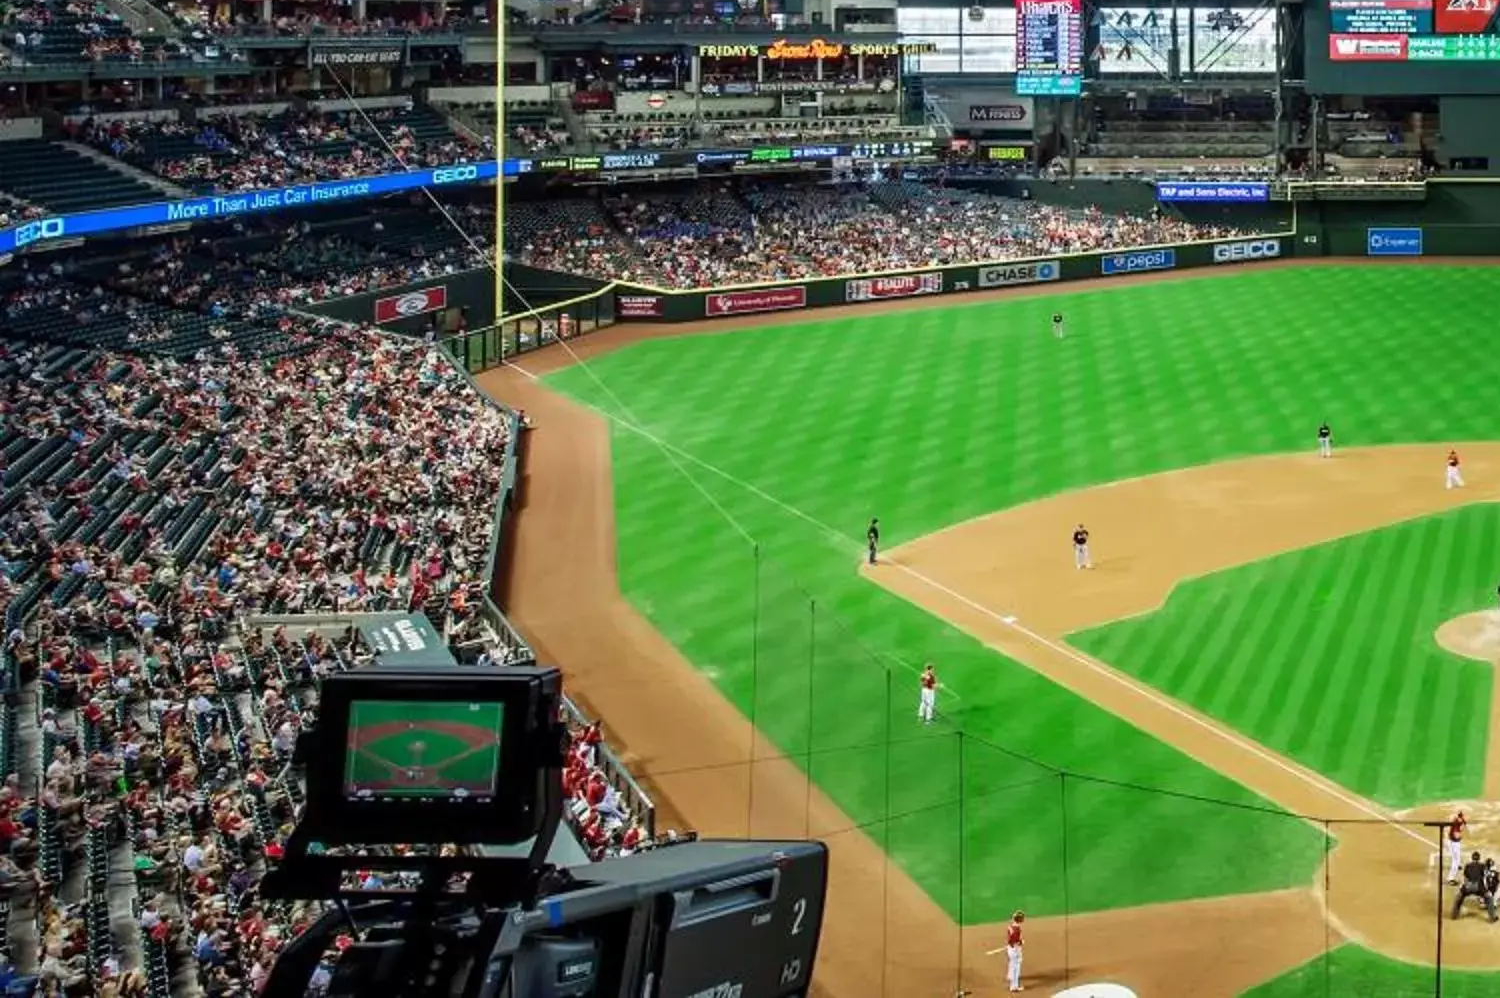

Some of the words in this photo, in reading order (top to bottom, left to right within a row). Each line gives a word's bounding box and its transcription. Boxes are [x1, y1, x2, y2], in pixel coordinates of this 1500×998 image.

[700, 44, 759, 57] FRIDAY'S
[850, 44, 899, 55] SPORTS
[167, 203, 209, 220] More
[213, 198, 246, 213] Than
[251, 193, 280, 209] Just
[284, 189, 307, 205] Car
[311, 182, 370, 202] Insurance
[432, 166, 477, 185] GEICO
[1127, 250, 1165, 267] pepsi
[1215, 240, 1280, 260] GEICO
[986, 266, 1037, 282] CHASE
[791, 898, 807, 936] 2
